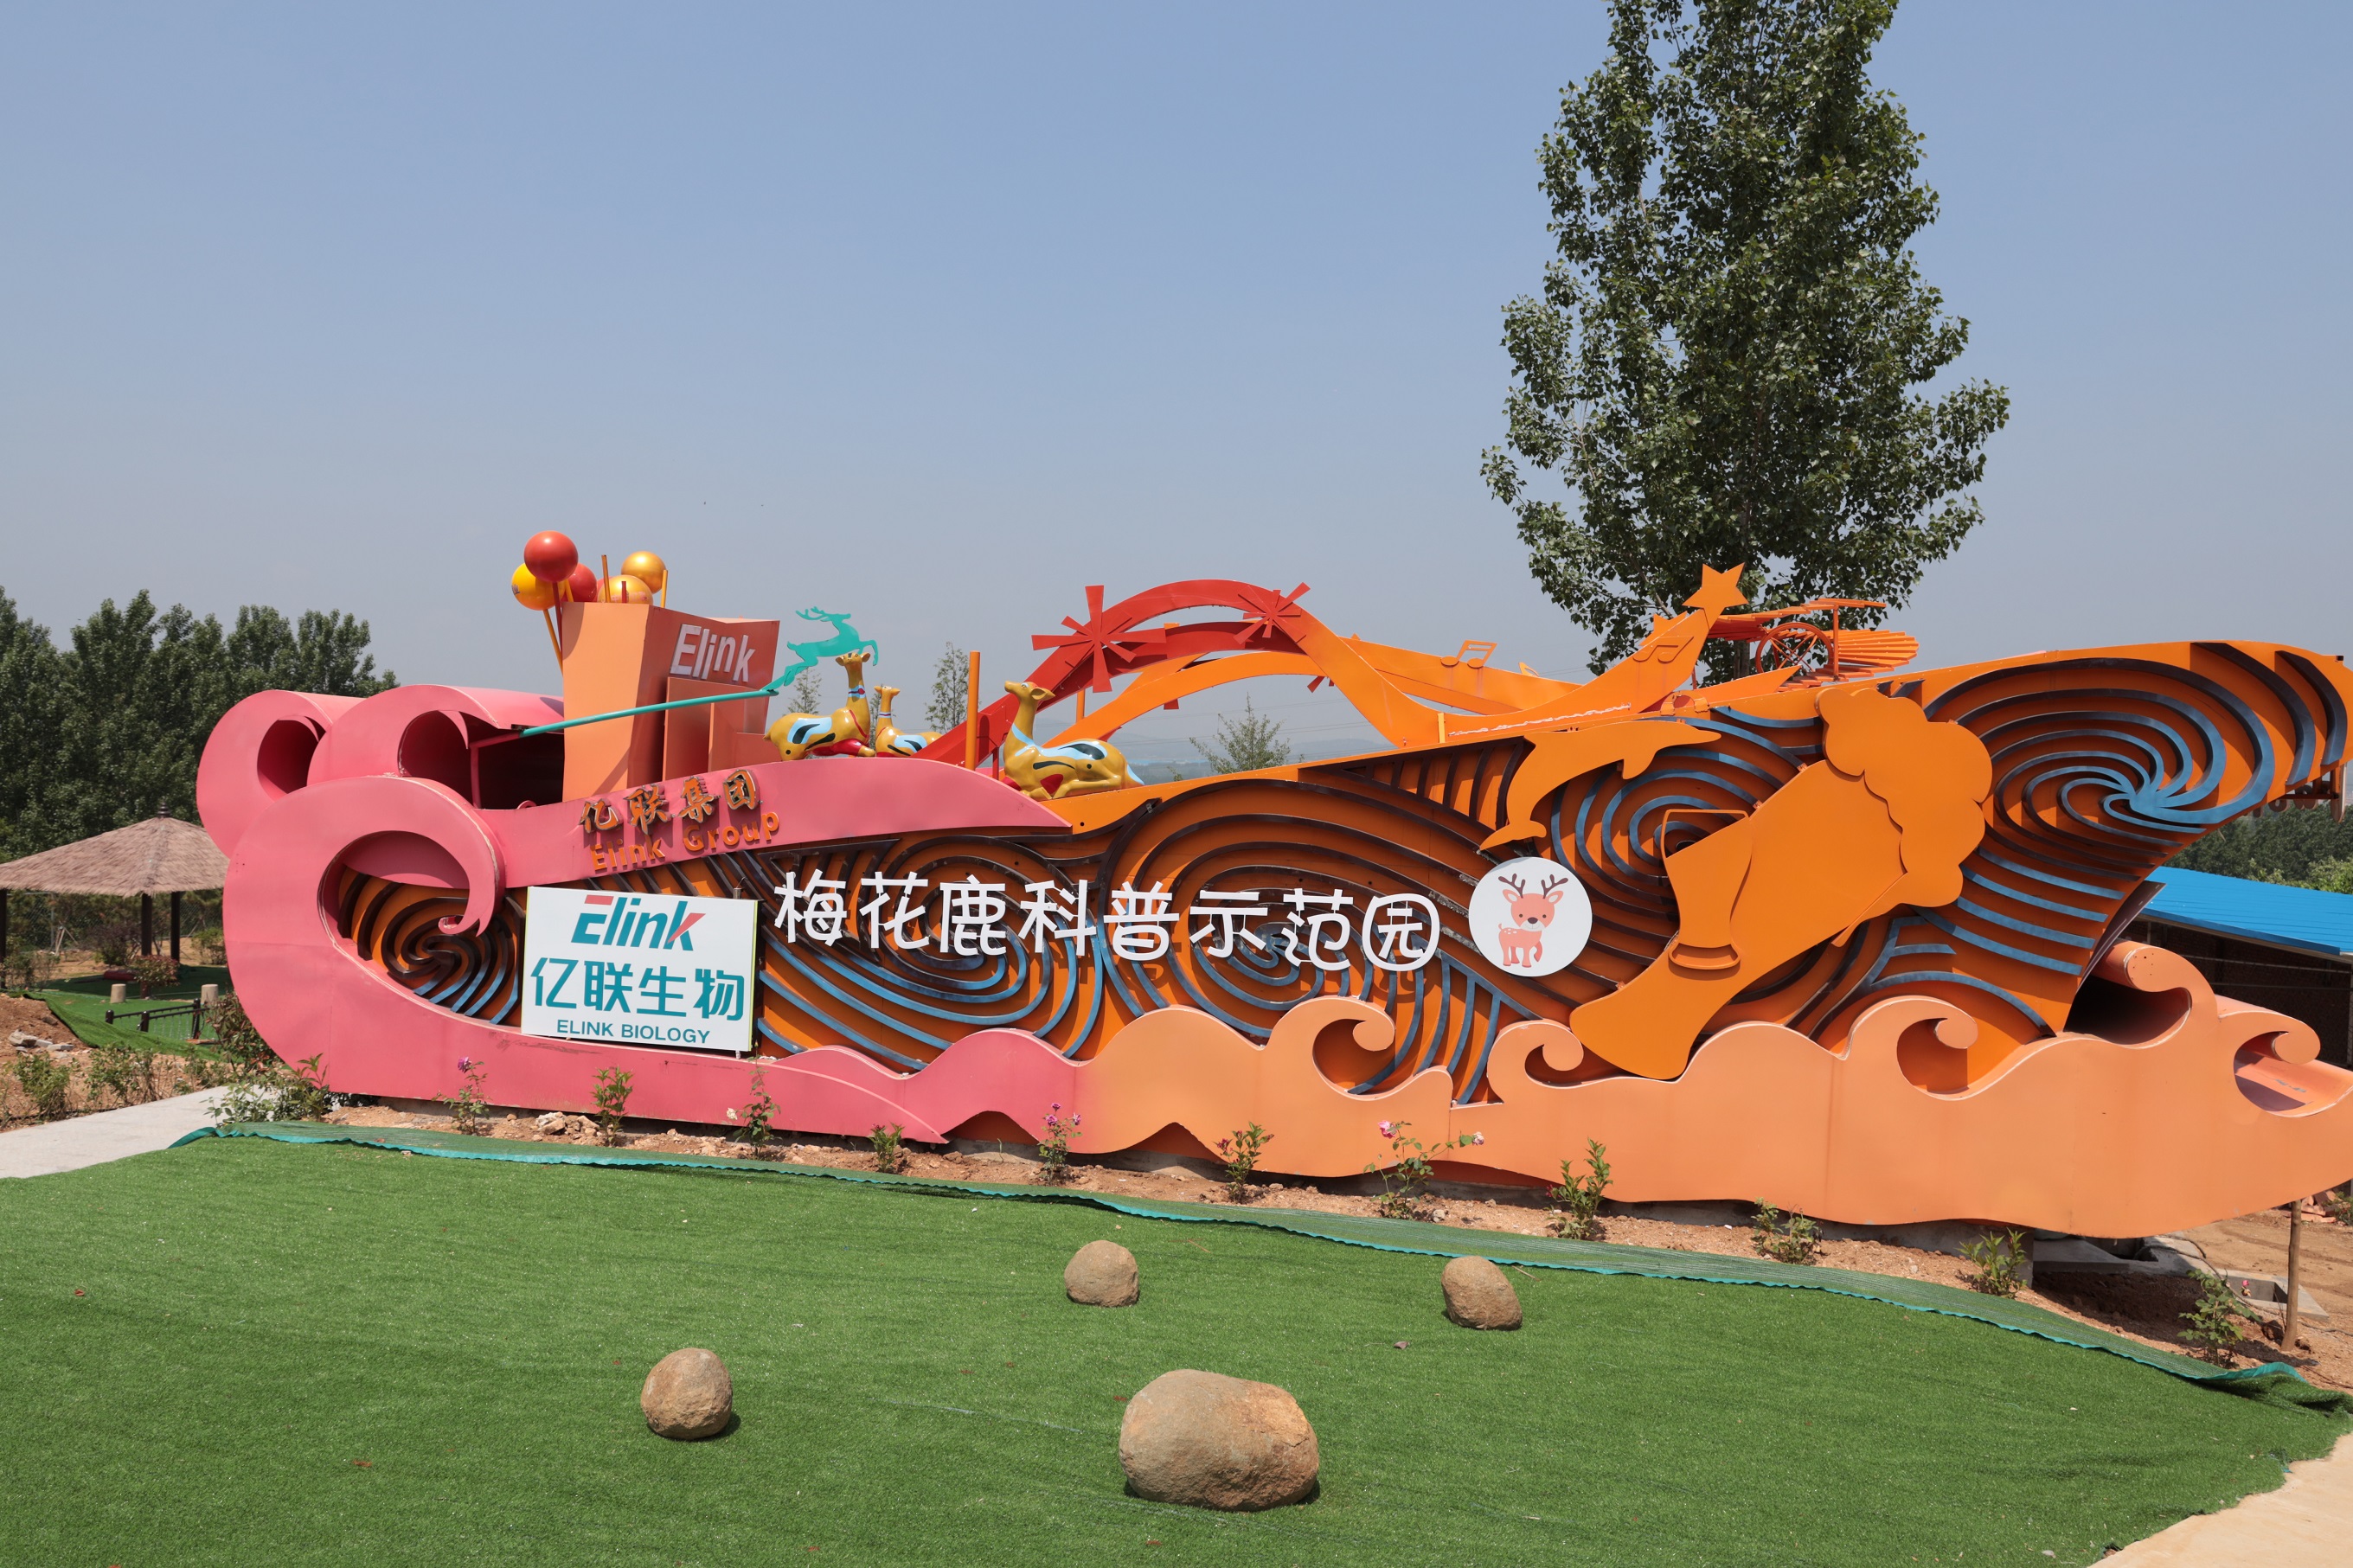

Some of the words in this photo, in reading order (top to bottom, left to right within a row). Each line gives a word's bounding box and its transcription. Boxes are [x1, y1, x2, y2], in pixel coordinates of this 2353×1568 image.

[670, 624, 756, 682] Elink
[579, 769, 757, 835] 亿联集团
[590, 834, 665, 871] Elink
[683, 811, 779, 851] Group
[571, 894, 706, 951] Elink
[773, 869, 1440, 972] 梅花鹿科普示范园
[530, 957, 744, 1021] 亿联生物
[557, 1019, 613, 1037] ELINK
[621, 1024, 710, 1044] BIOLOGY
